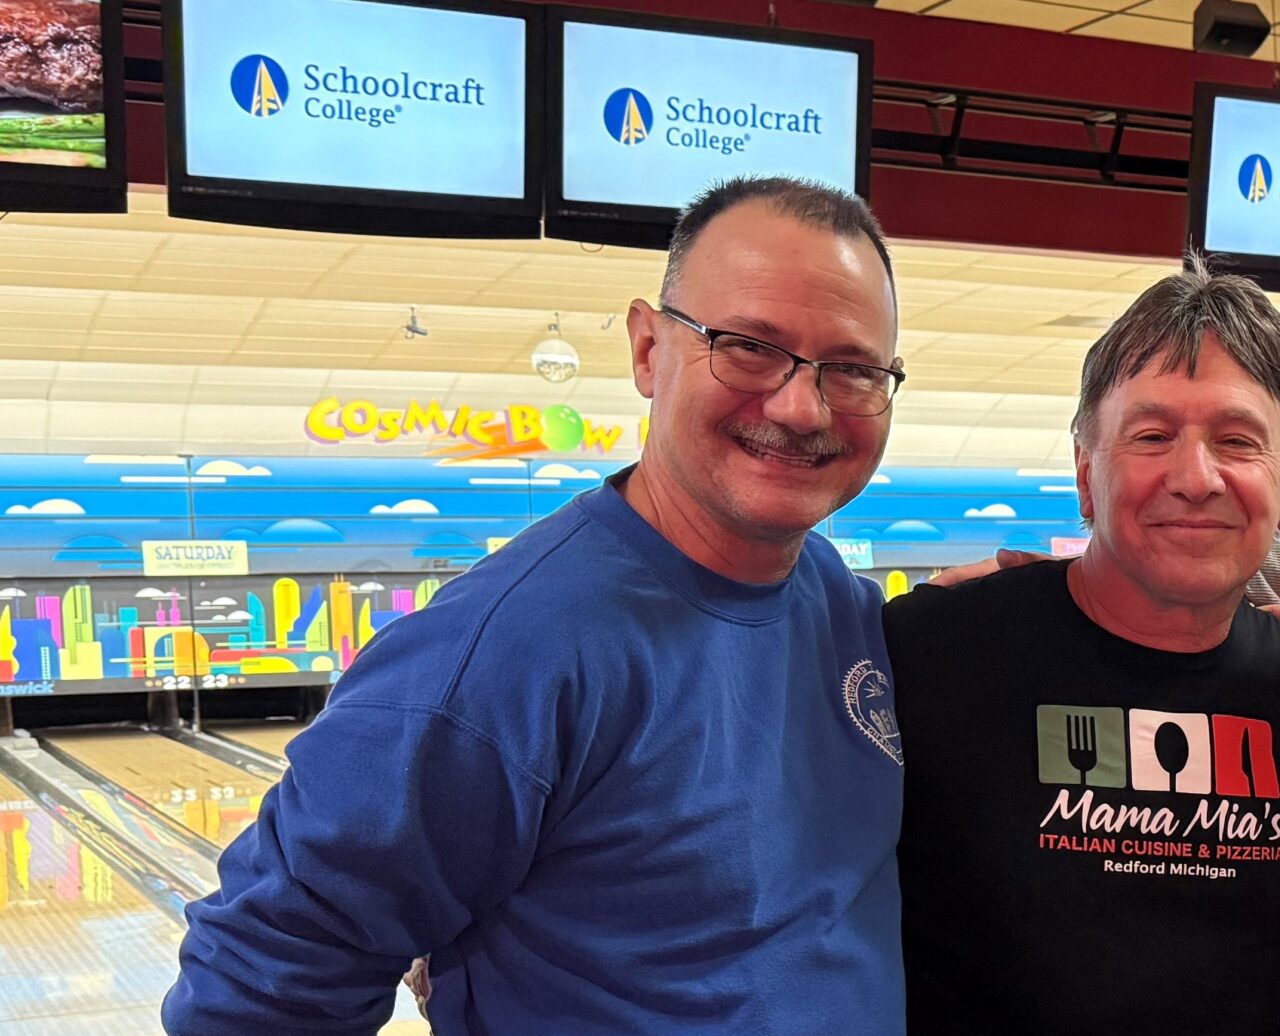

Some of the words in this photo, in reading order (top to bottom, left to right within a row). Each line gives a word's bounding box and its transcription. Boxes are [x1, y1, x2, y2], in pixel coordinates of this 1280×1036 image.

[303, 63, 485, 106] Schoolcraft
[666, 96, 822, 135] Schoolcraft
[154, 545, 235, 562] SATURDAY
[163, 675, 191, 690] 22
[202, 673, 229, 688] 23
[847, 666, 868, 705] REDFORD
[1040, 788, 1180, 836] Mama
[1039, 833, 1117, 854] ITALIAN
[1121, 840, 1193, 858] CUISINE
[1198, 846, 1211, 859] &
[1104, 860, 1166, 875] Redford
[1170, 863, 1237, 879] Michigan
